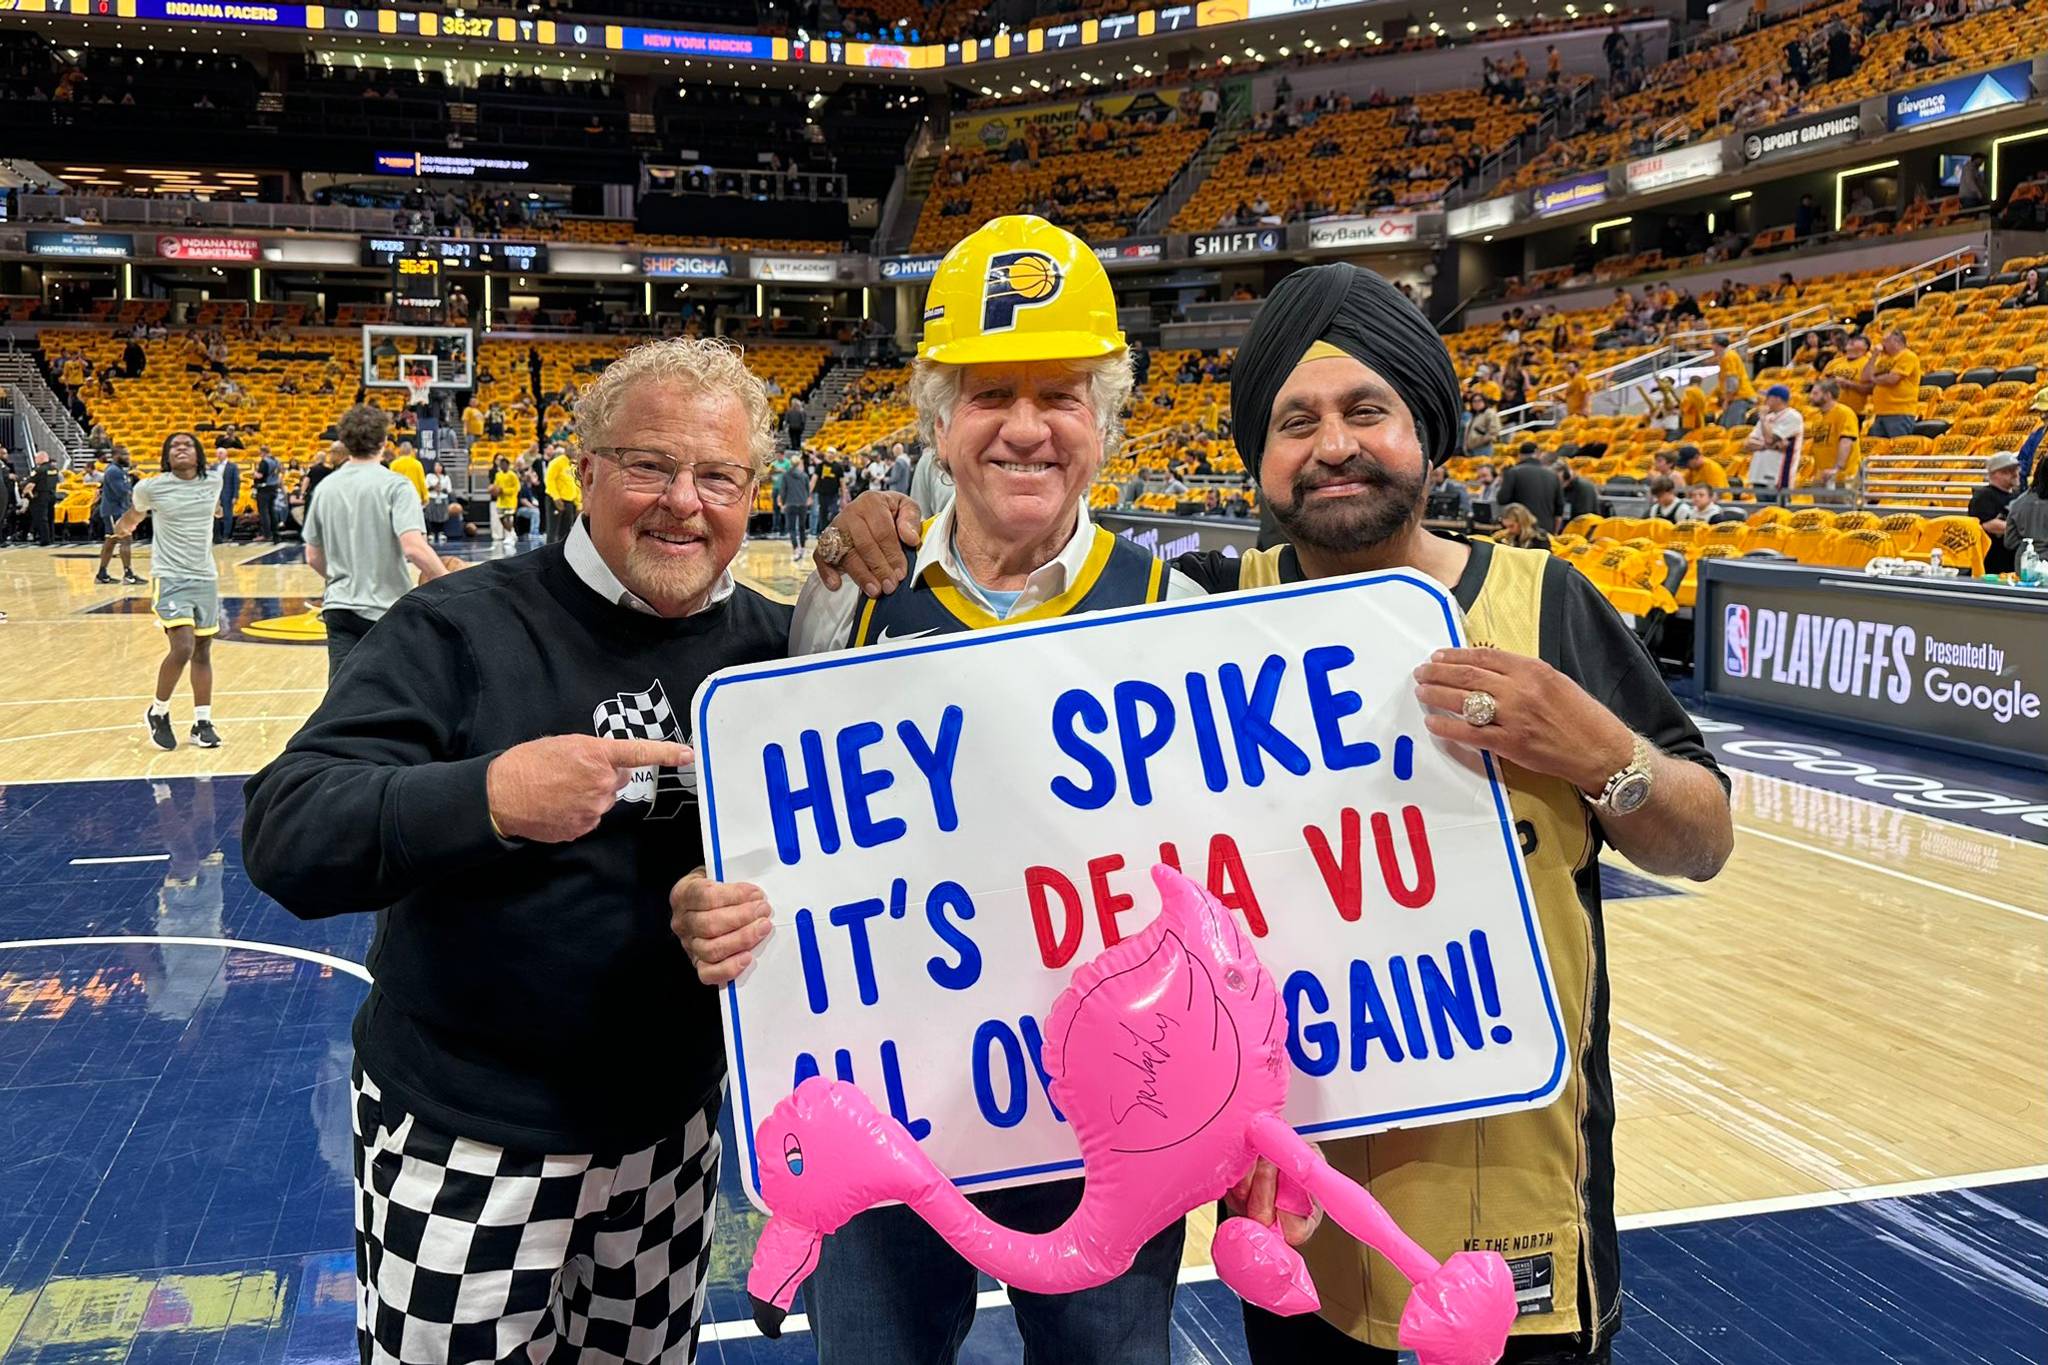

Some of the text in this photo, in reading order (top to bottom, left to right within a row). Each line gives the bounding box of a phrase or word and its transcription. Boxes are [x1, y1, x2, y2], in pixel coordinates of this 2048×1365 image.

[166, 2, 278, 21] INDIANA PACERS
[344, 10, 359, 28] 0
[573, 25, 587, 44] 0
[643, 34, 753, 53] NEW YORK KNICKS
[1897, 94, 1946, 115] Elevance
[1763, 130, 1799, 152] SPORT
[1801, 115, 1859, 142] GRAPHICS
[1310, 221, 1376, 243] KeyBank
[182, 238, 258, 249] INDIANA FEVER
[188, 247, 252, 257] BASKETBALL
[1194, 231, 1274, 255] SHIFT 4
[398, 259, 438, 274] 36:27
[642, 255, 729, 274] SHIPSIGMA
[411, 299, 442, 308] TISSOT
[1752, 608, 1916, 704] PLAYOFFS
[1924, 636, 2005, 676] Presented by
[1923, 667, 2041, 723] Google
[763, 645, 1414, 866] HEY SPIKE,
[795, 805, 1436, 1014] IT'S DEA VU
[1282, 929, 1513, 1077] GAIN!
[1463, 1232, 1553, 1252] WE THE NORTH
